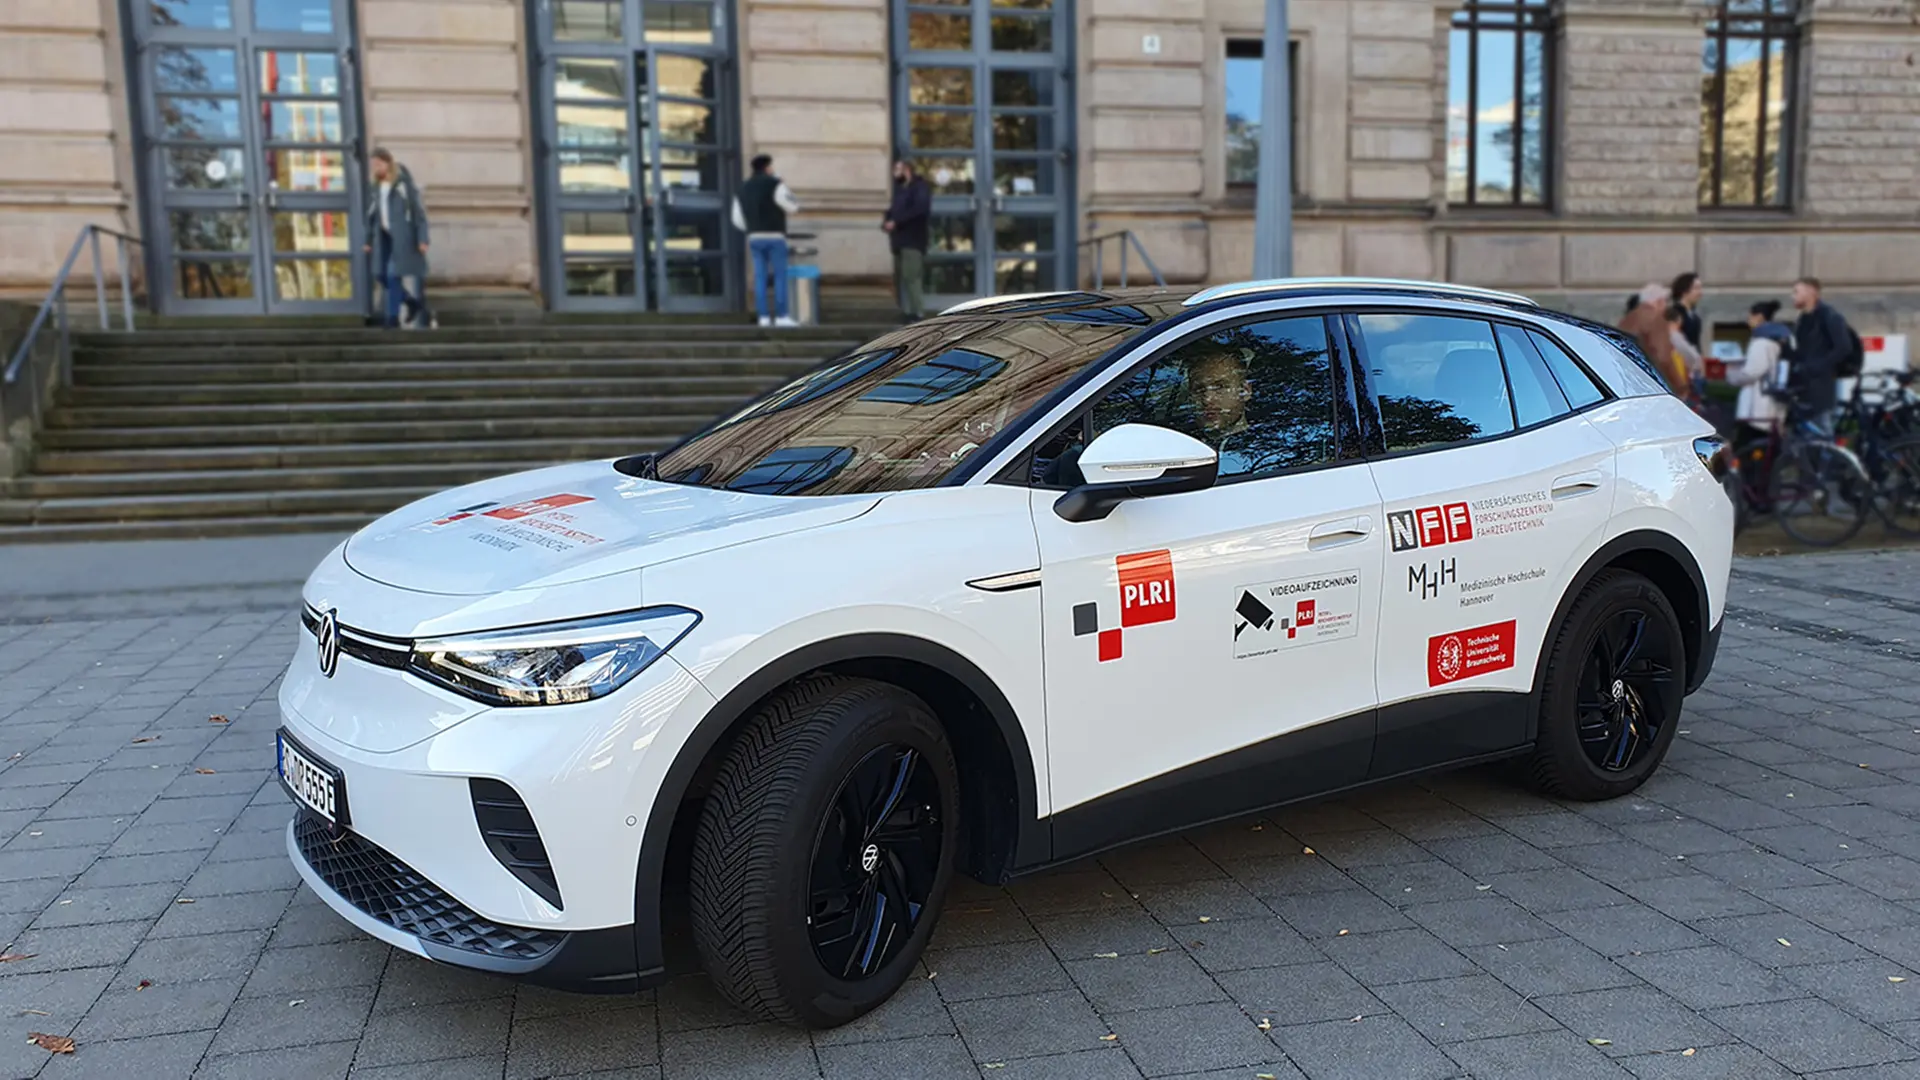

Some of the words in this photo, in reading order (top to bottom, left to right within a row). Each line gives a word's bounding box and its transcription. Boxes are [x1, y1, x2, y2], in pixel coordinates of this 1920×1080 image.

[1475, 503, 1554, 524] FORSCHUNGSZENTRUM
[1390, 505, 1469, 549] NFF
[1477, 519, 1545, 538] FAHRZEUGTECHNIK
[1270, 575, 1358, 596] VIDEOAUFZEICHNUNG
[1460, 574, 1506, 592] Medizinische
[1507, 567, 1547, 583] Hochschule
[1124, 579, 1171, 608] PLRI
[1460, 594, 1494, 608] Hannover
[1297, 609, 1314, 620] PLRI
[1467, 633, 1500, 646] Technische
